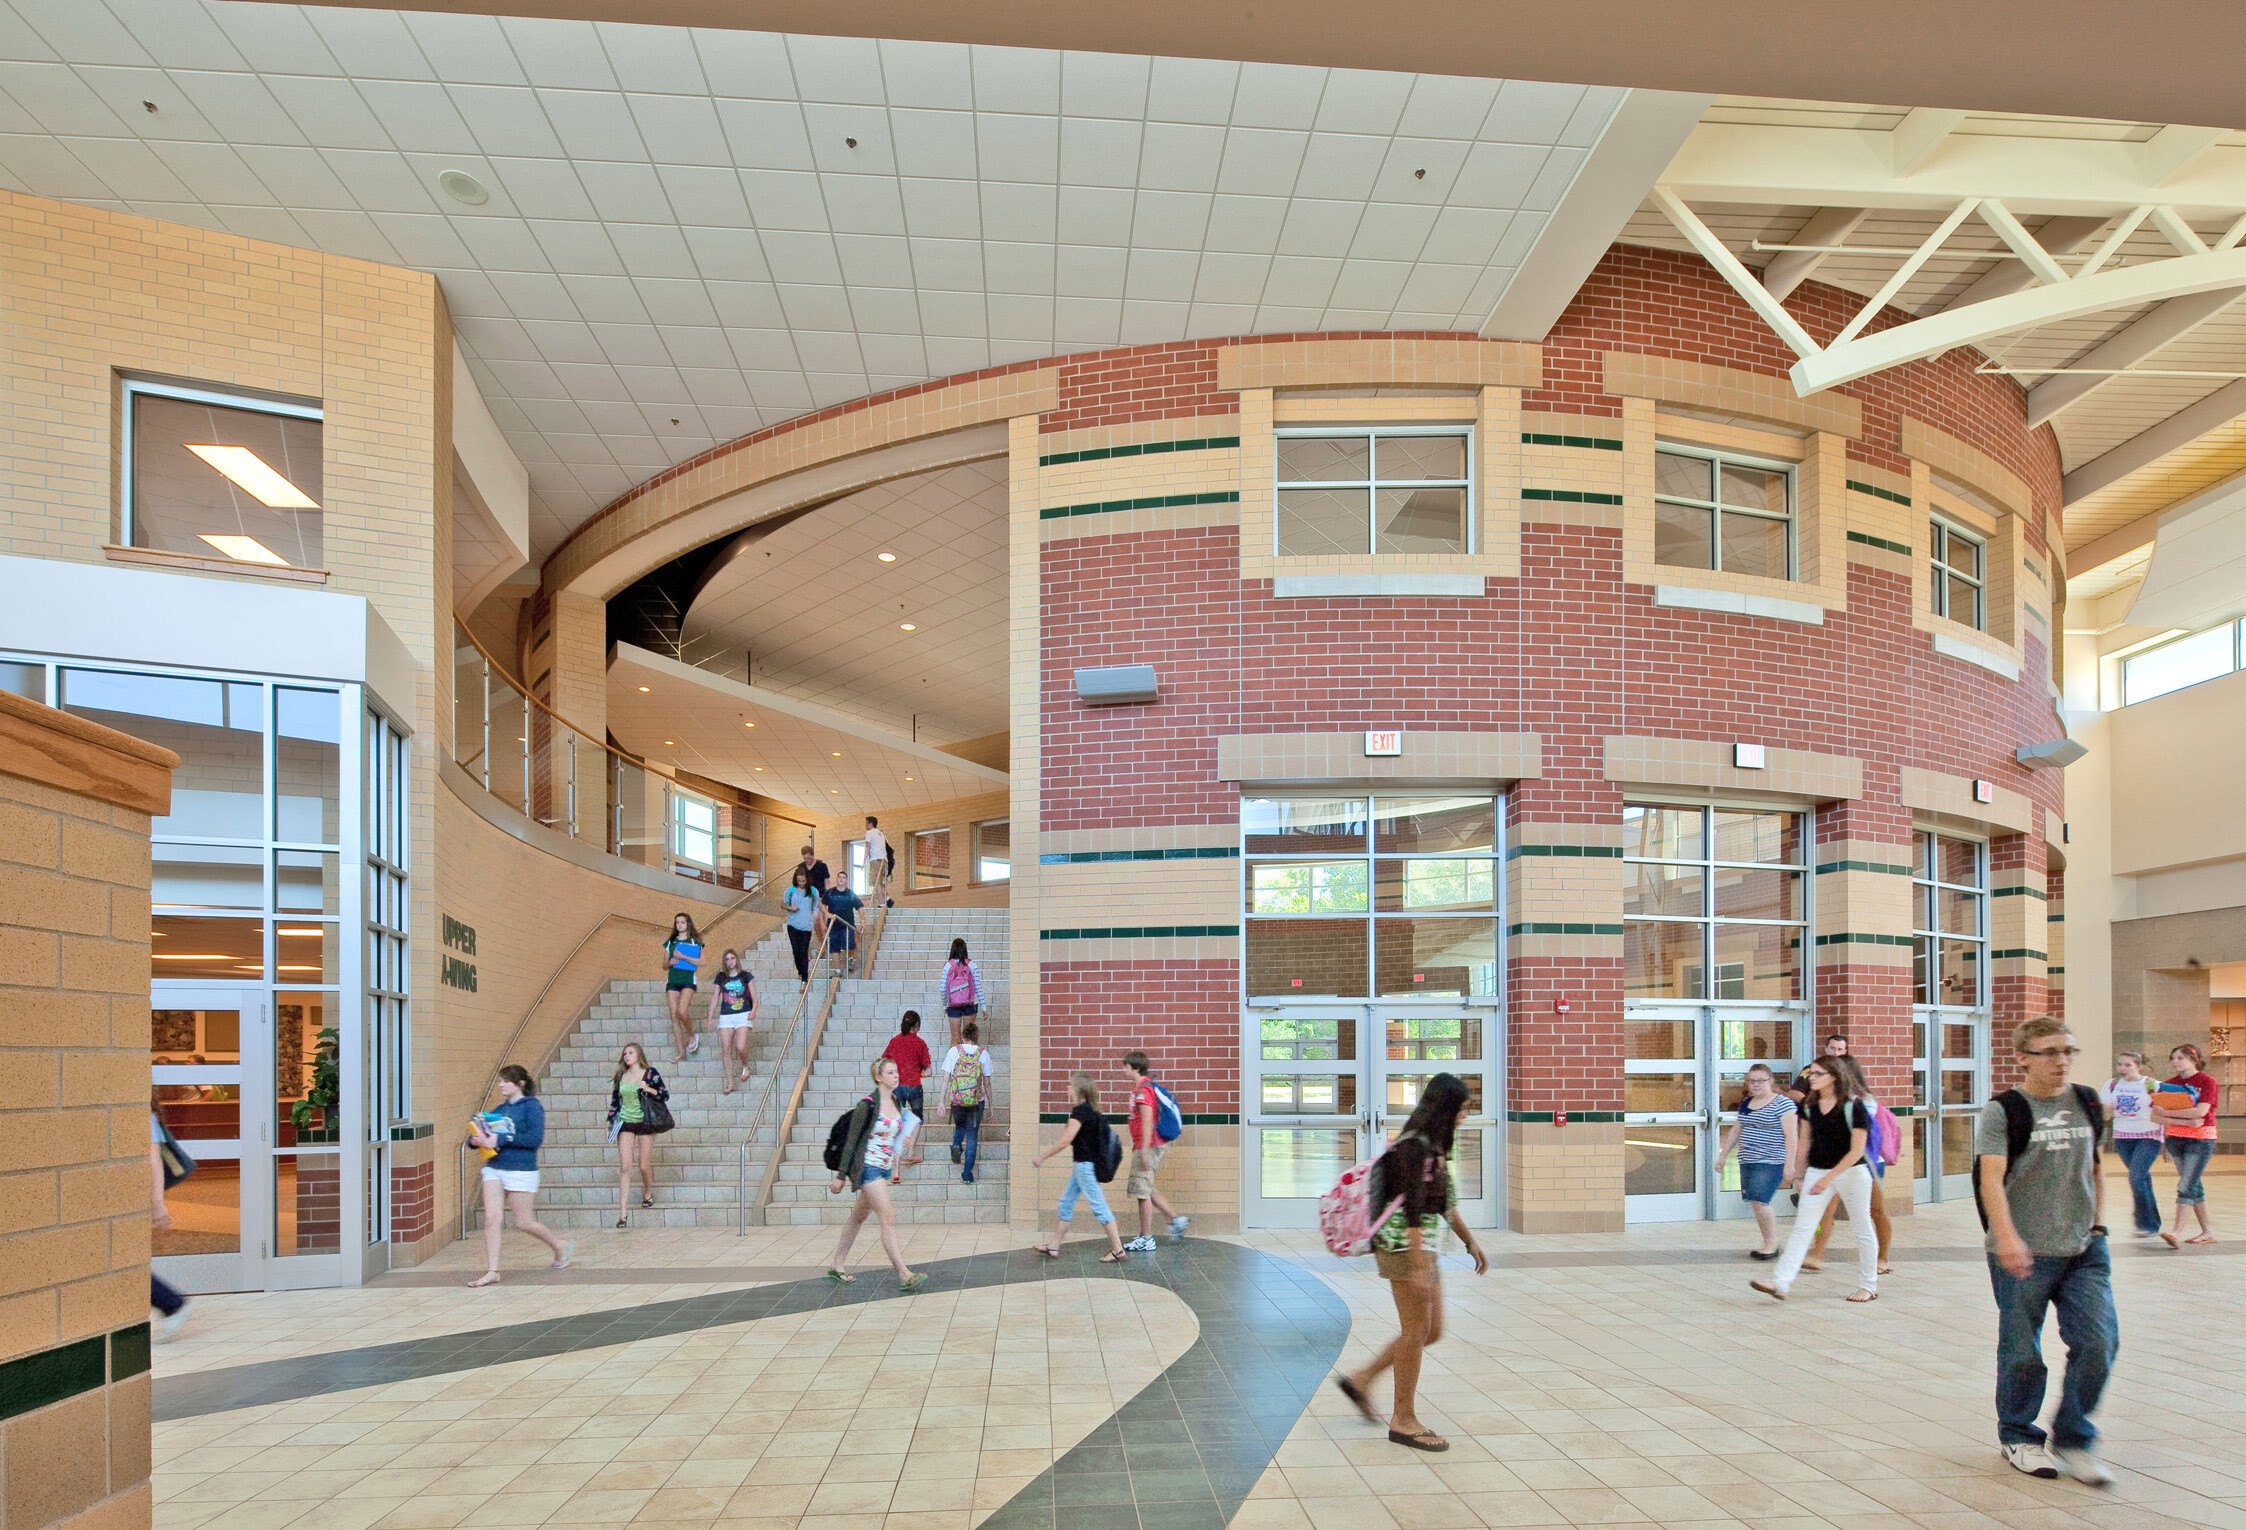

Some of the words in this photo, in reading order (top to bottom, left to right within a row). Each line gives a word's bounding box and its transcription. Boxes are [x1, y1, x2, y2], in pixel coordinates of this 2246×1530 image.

[1372, 733, 1396, 751] EXIT
[442, 912, 477, 956] UPPER
[440, 953, 478, 993] A-WING
